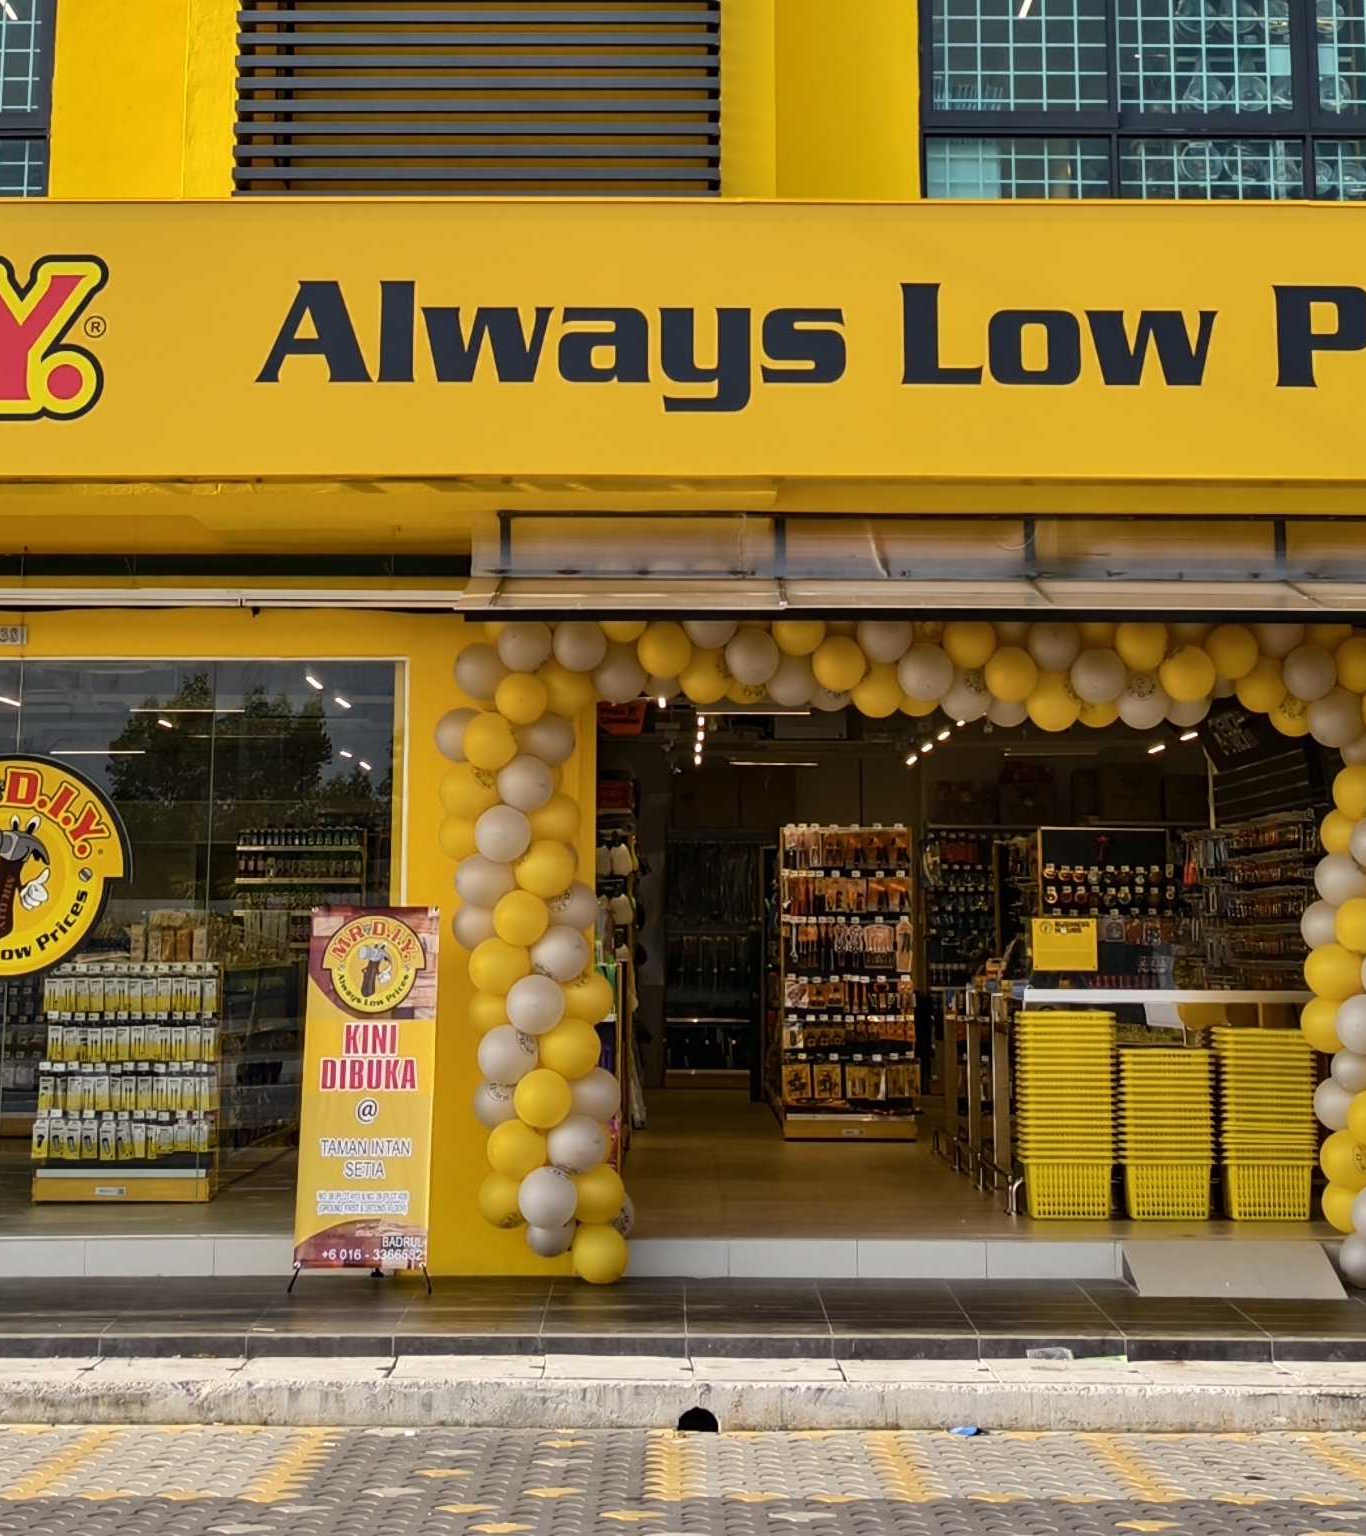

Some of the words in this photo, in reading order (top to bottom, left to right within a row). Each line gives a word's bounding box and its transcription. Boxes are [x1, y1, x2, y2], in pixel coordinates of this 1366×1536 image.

[253, 279, 847, 412] Always
[899, 281, 1218, 387] Low
[36, 889, 88, 951] Prices
[337, 972, 362, 1004] Always
[363, 998, 384, 1007] Low
[385, 974, 410, 1003] Prices
[344, 1024, 398, 1054] KINI
[321, 1059, 417, 1090] DIBUKA
[357, 1099, 378, 1123] @
[320, 1139, 367, 1156] TAMAN
[371, 1139, 411, 1156] INTAN
[344, 1161, 385, 1178] SETIA
[339, 1249, 362, 1261] 016
[382, 1236, 423, 1248] BADRUL
